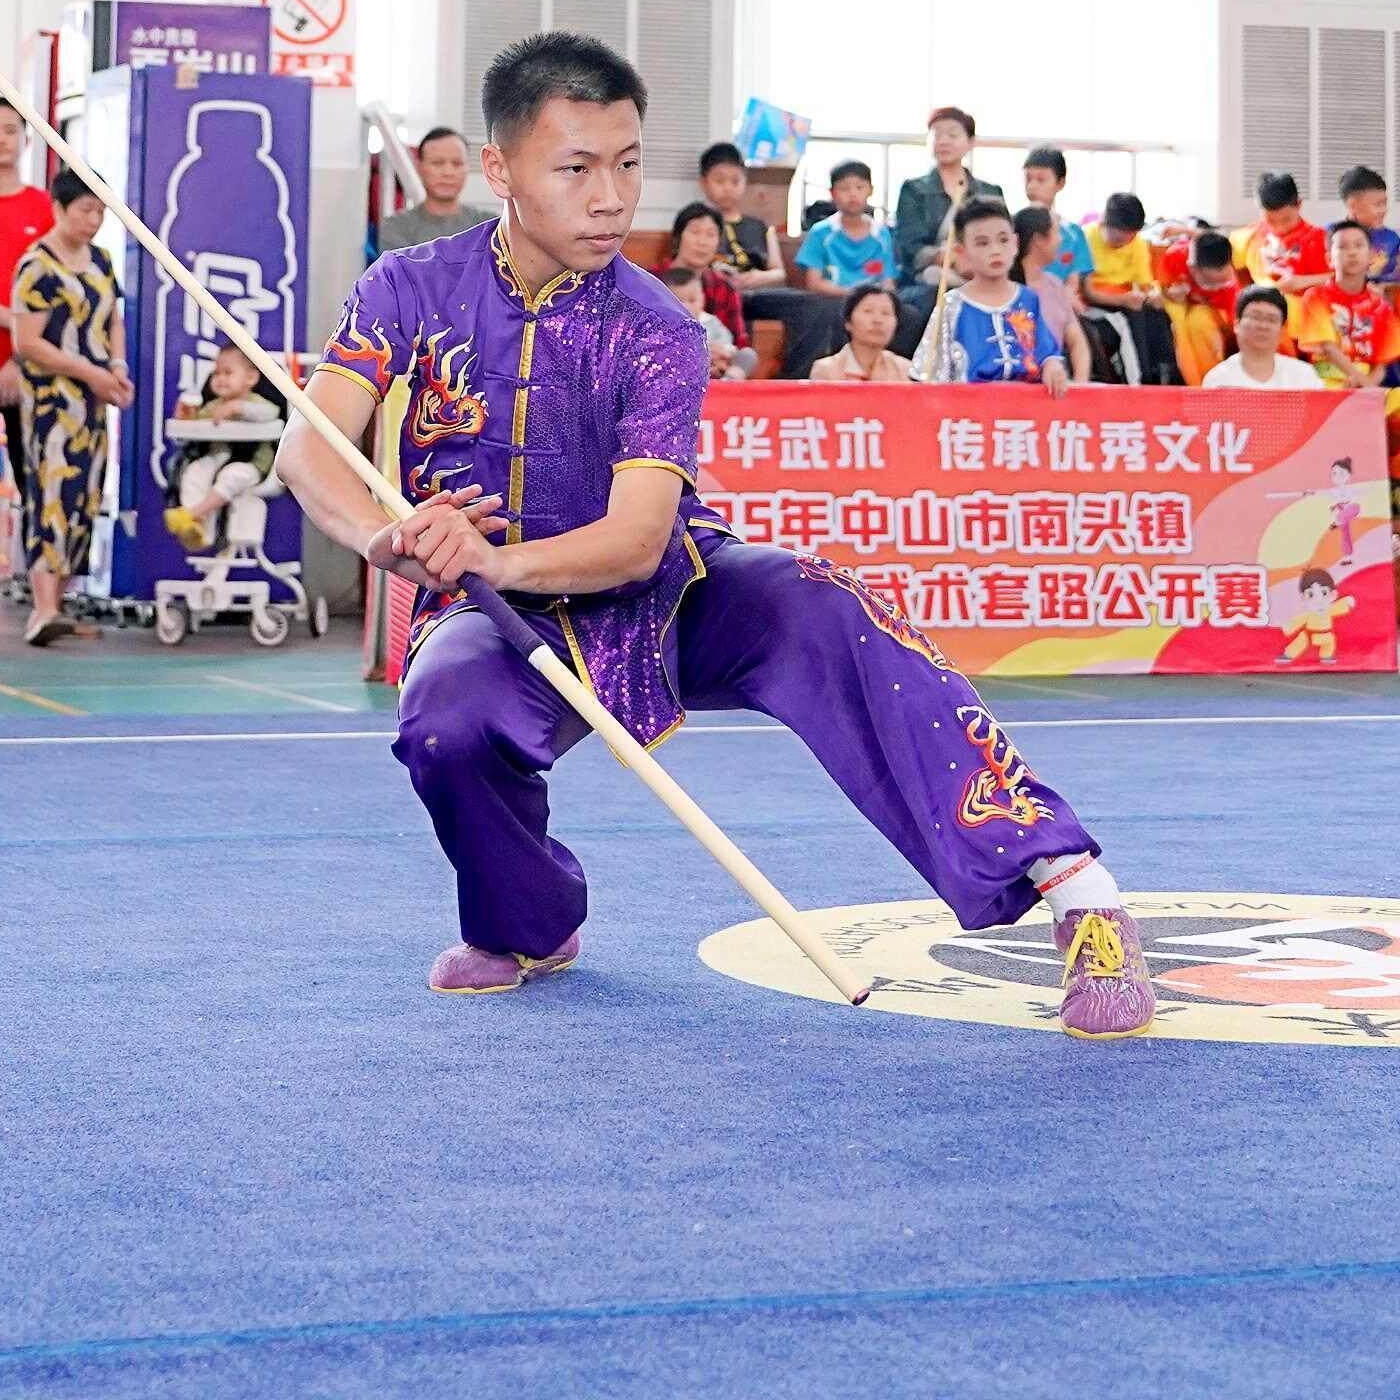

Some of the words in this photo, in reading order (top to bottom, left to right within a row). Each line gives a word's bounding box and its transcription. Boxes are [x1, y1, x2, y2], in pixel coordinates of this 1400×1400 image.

[937, 418, 1254, 474] 传承优秀文化
